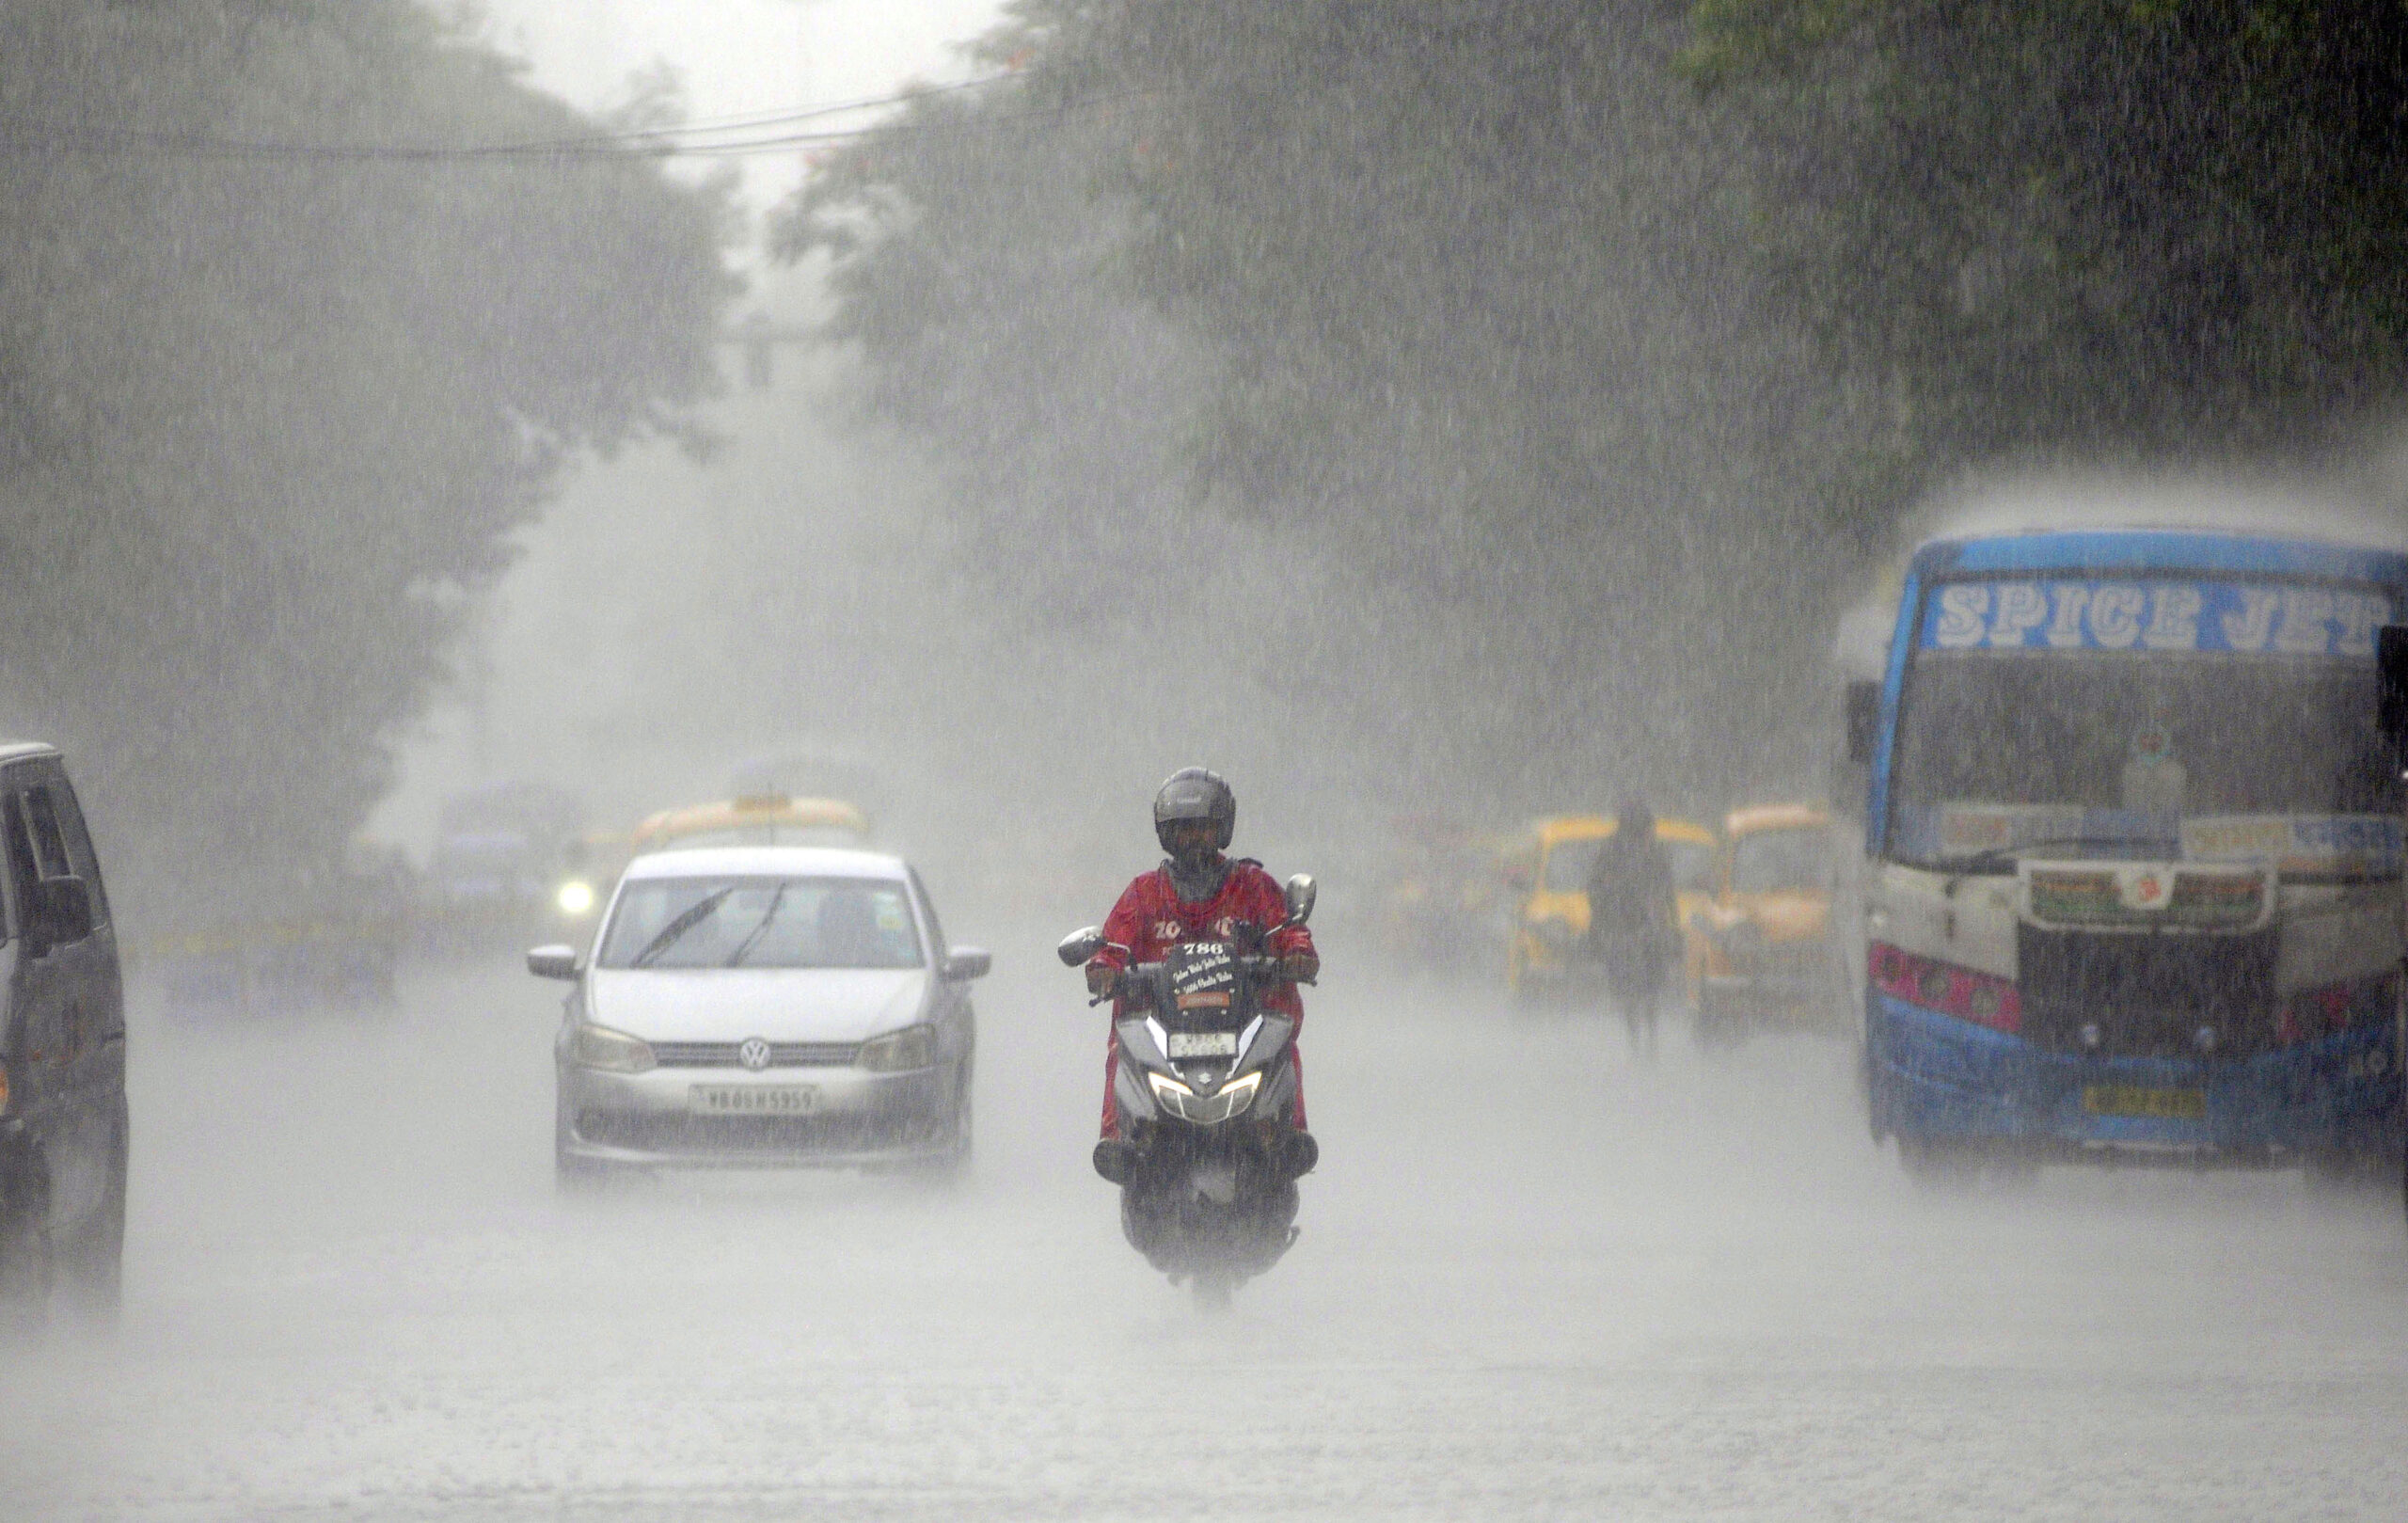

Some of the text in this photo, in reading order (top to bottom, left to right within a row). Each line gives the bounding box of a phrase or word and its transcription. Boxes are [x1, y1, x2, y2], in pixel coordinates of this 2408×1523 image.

[1936, 583, 2392, 656] SPICE JET
[1183, 943, 1224, 956] 786
